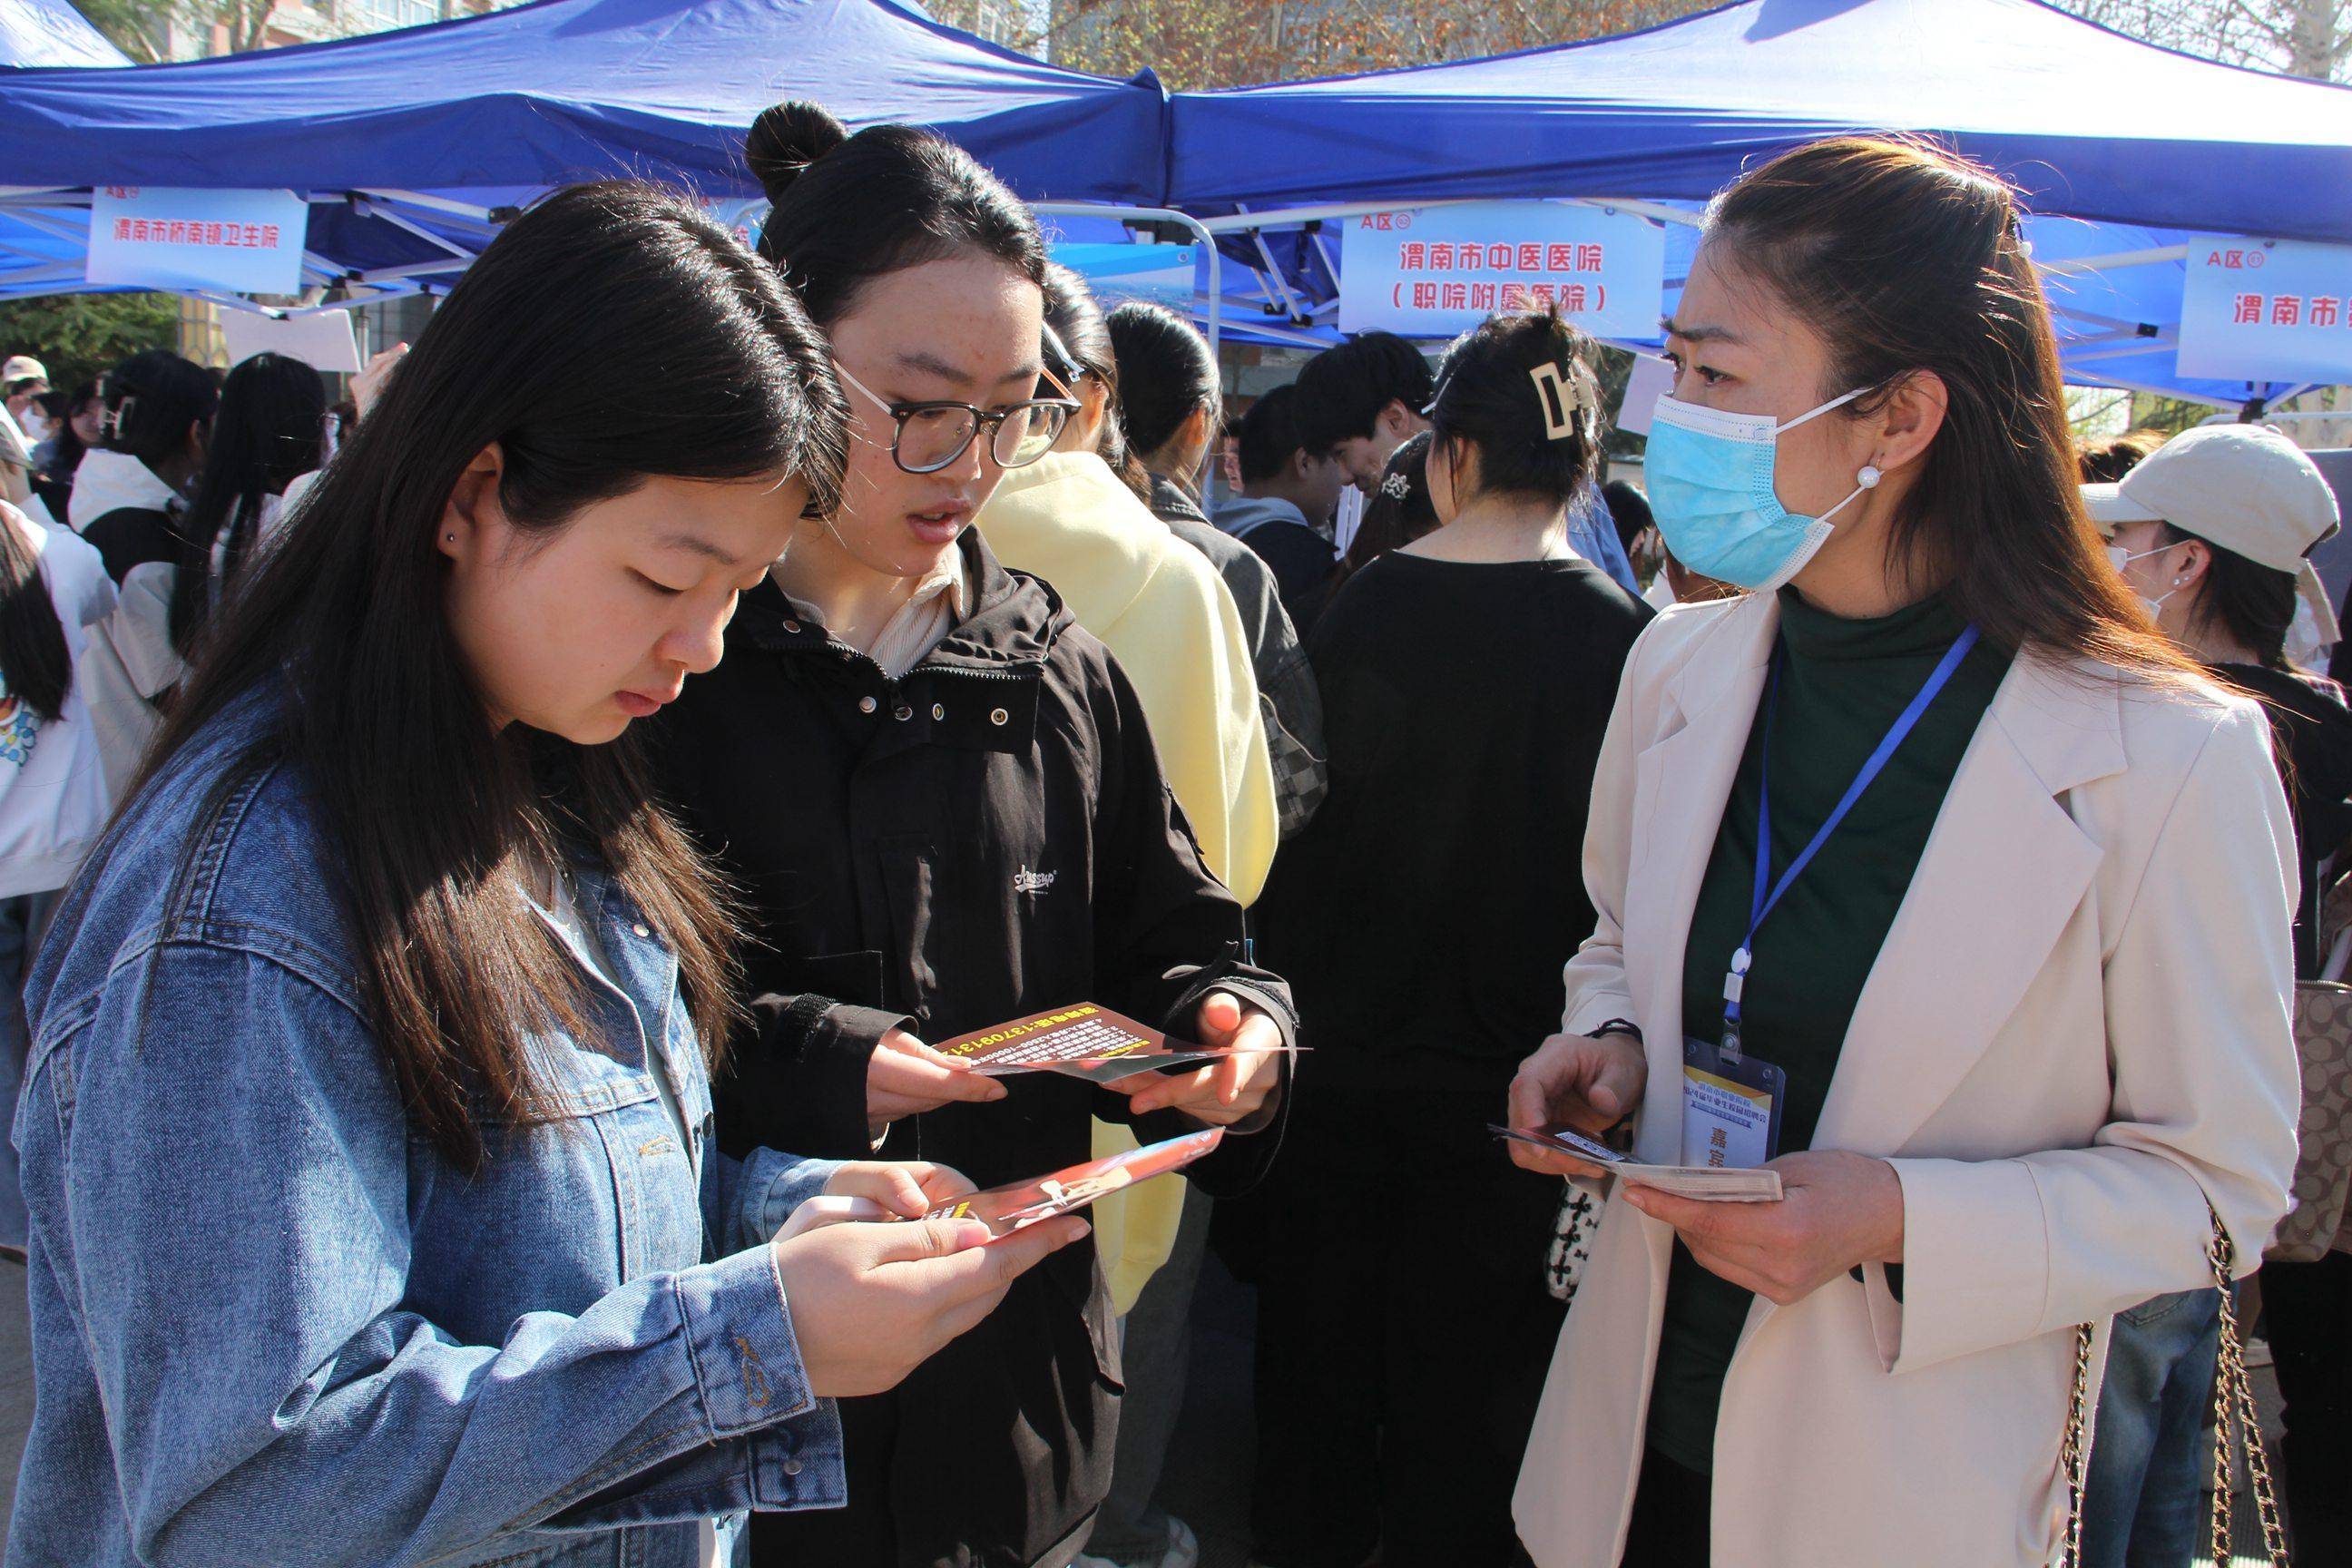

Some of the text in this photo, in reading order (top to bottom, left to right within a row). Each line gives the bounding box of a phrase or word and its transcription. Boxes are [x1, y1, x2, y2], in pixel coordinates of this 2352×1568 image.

[113, 217, 280, 249] 渭南市桥南镇卫生院
[1399, 242, 1603, 273] 渭南市中医医院
[2233, 292, 2352, 328] 渭南市
[942, 1006, 1099, 1056] 咨询电话:13709131
[1708, 1126, 1728, 1169] 嘉宾
